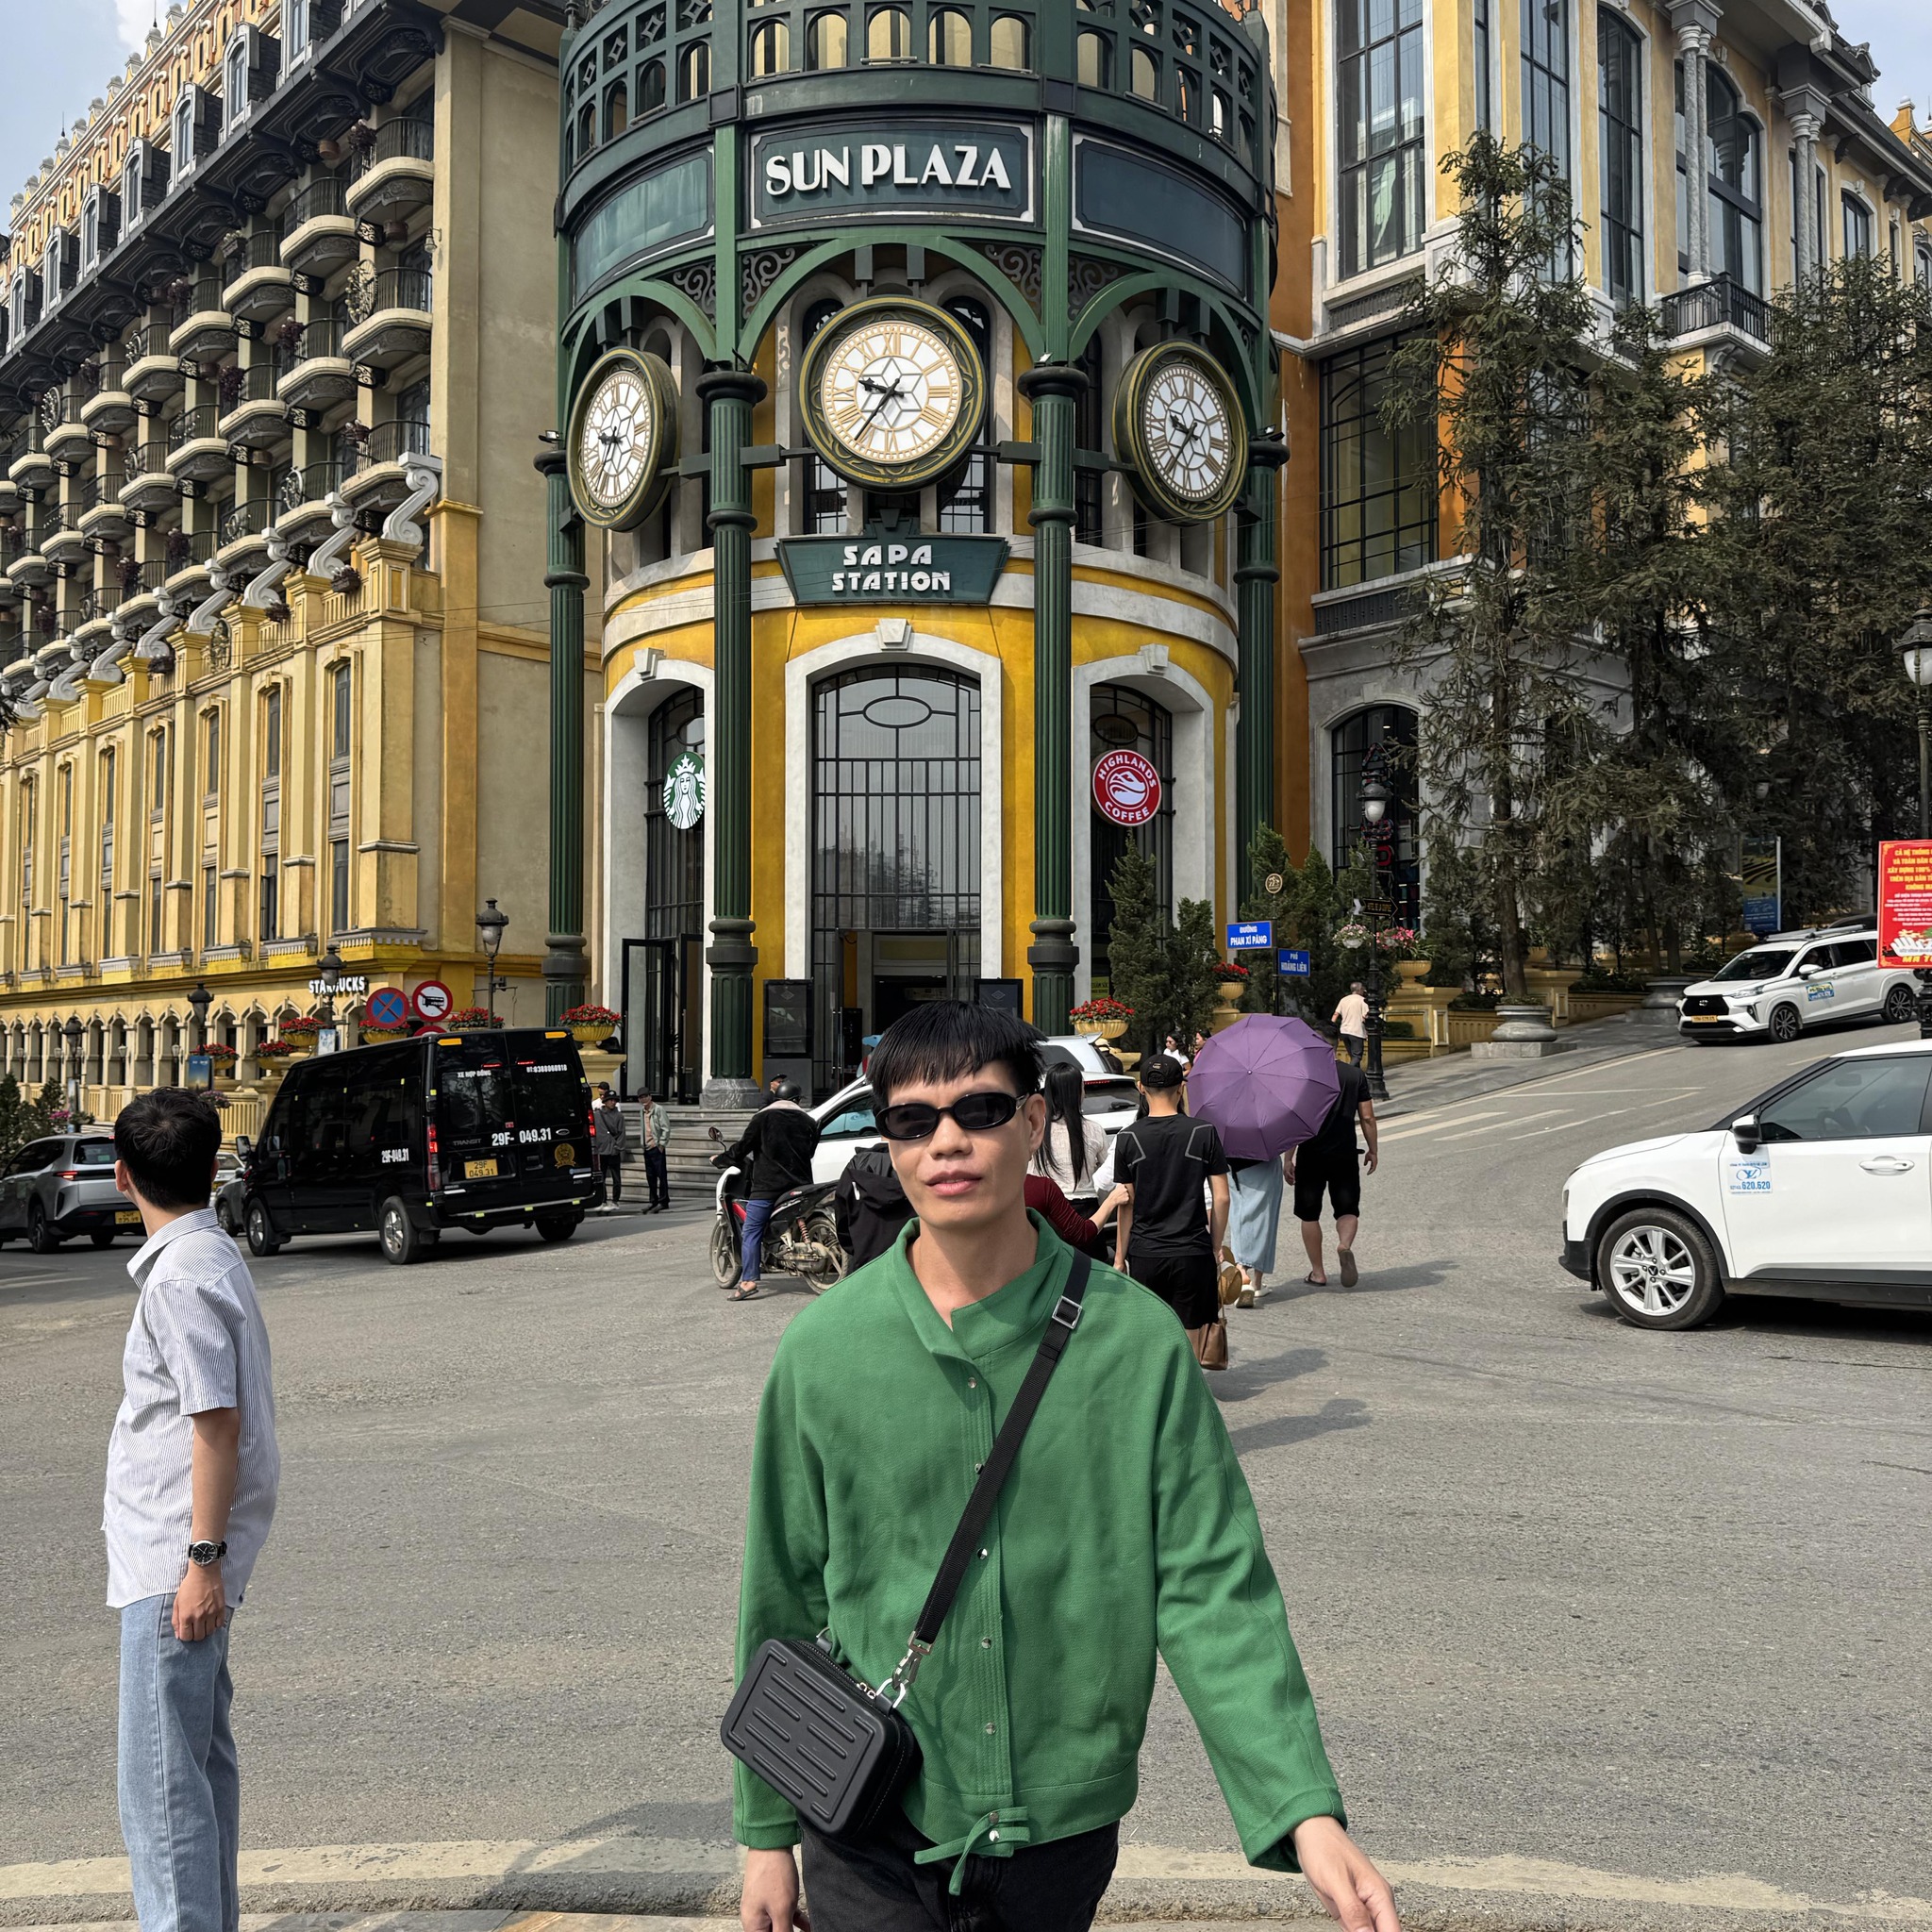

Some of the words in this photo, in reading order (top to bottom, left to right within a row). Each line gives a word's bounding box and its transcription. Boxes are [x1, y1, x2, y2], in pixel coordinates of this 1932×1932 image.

[765, 146, 849, 196] SUN
[861, 144, 1012, 189] PLAZA
[843, 544, 932, 566] SAPA
[831, 571, 951, 591] STATION
[1098, 755, 1157, 788] HIGHLANDS
[1105, 801, 1150, 822] COFFEE
[1230, 937, 1244, 945] PHAN
[453, 1138, 482, 1146] TRANSIT
[519, 1127, 552, 1143] 049.31
[469, 1168, 494, 1178] 049.31
[474, 1161, 488, 1170] 29F
[1741, 1181, 1771, 1190] 620.620
